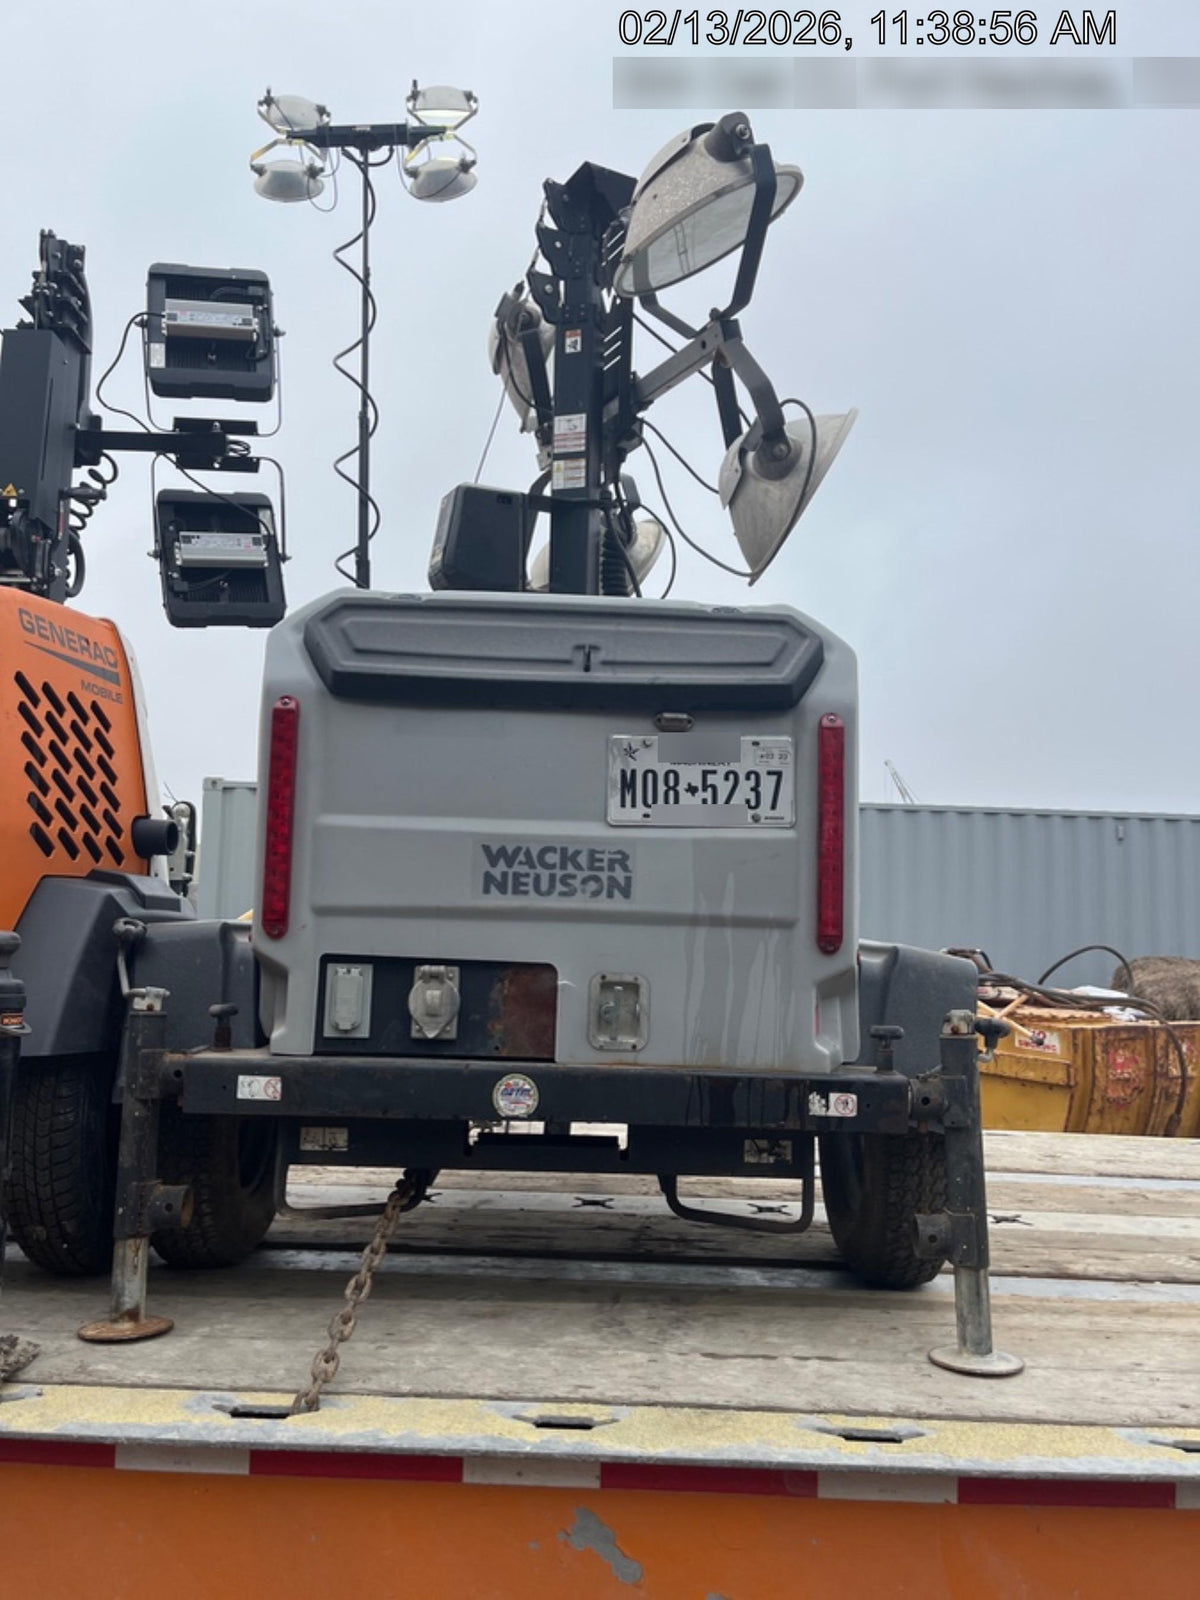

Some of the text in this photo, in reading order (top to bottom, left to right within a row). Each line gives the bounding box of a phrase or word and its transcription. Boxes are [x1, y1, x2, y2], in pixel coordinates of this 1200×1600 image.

[18, 607, 118, 669] GENERAC
[80, 679, 123, 704] MOBILE
[481, 844, 632, 873] WACKER
[482, 871, 632, 899] NEUSON
